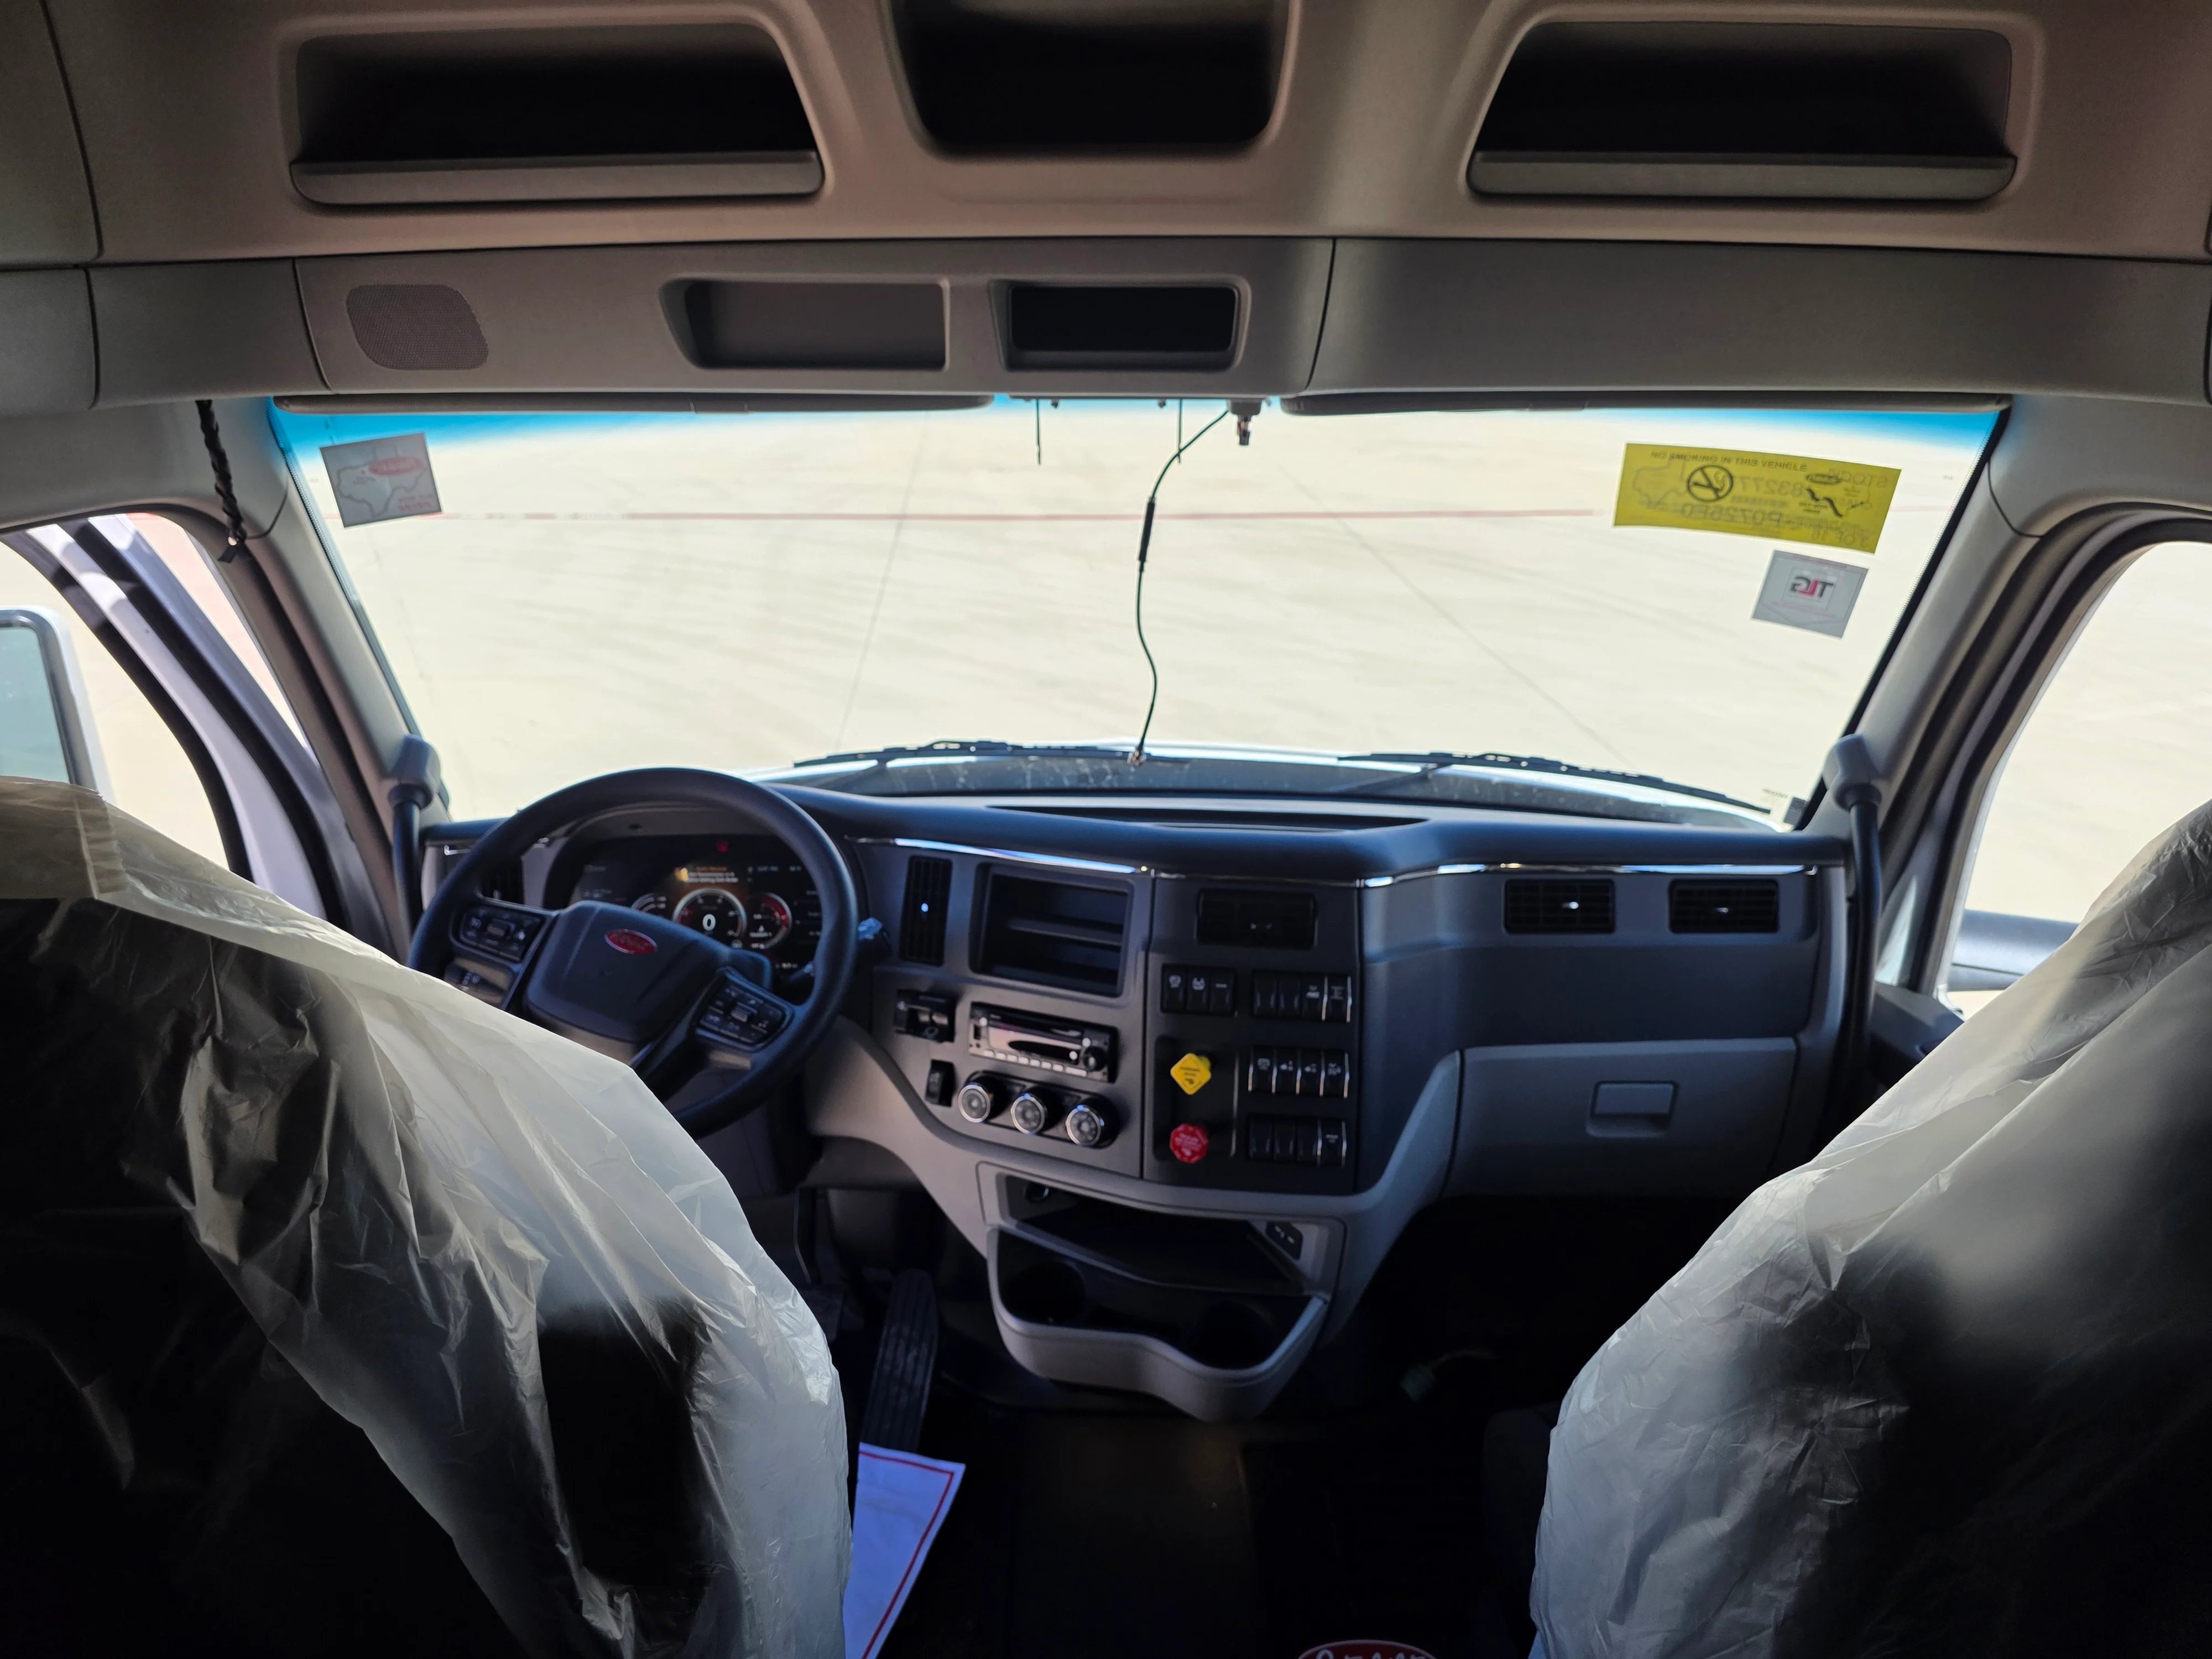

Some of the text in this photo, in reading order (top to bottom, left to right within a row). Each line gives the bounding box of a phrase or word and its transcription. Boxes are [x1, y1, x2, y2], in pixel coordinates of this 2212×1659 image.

[1670, 452, 1717, 463] SMOKING
[1735, 458, 1758, 467] THIS
[1761, 459, 1808, 471] VEHICLE
[702, 914, 716, 931] 0
